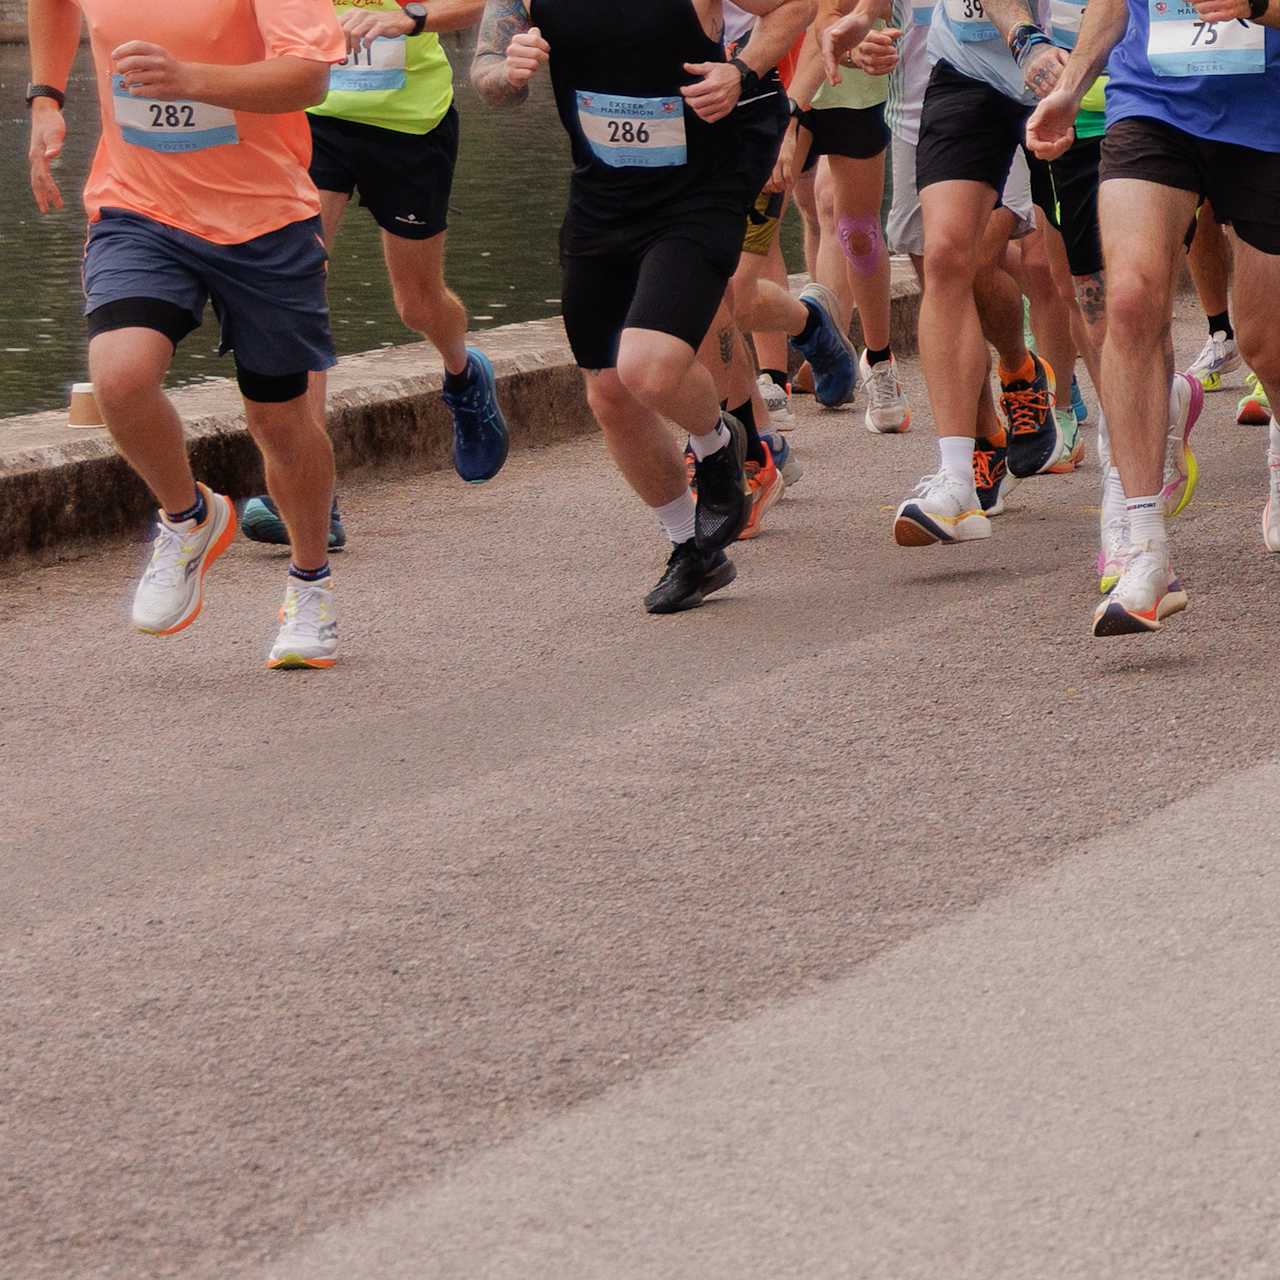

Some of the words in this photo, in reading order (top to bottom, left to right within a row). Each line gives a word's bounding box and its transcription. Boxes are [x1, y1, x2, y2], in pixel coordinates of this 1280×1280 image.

[1191, 22, 1218, 46] 75
[149, 104, 196, 127] 282
[600, 107, 654, 116] MARATHON
[608, 121, 650, 143] 286
